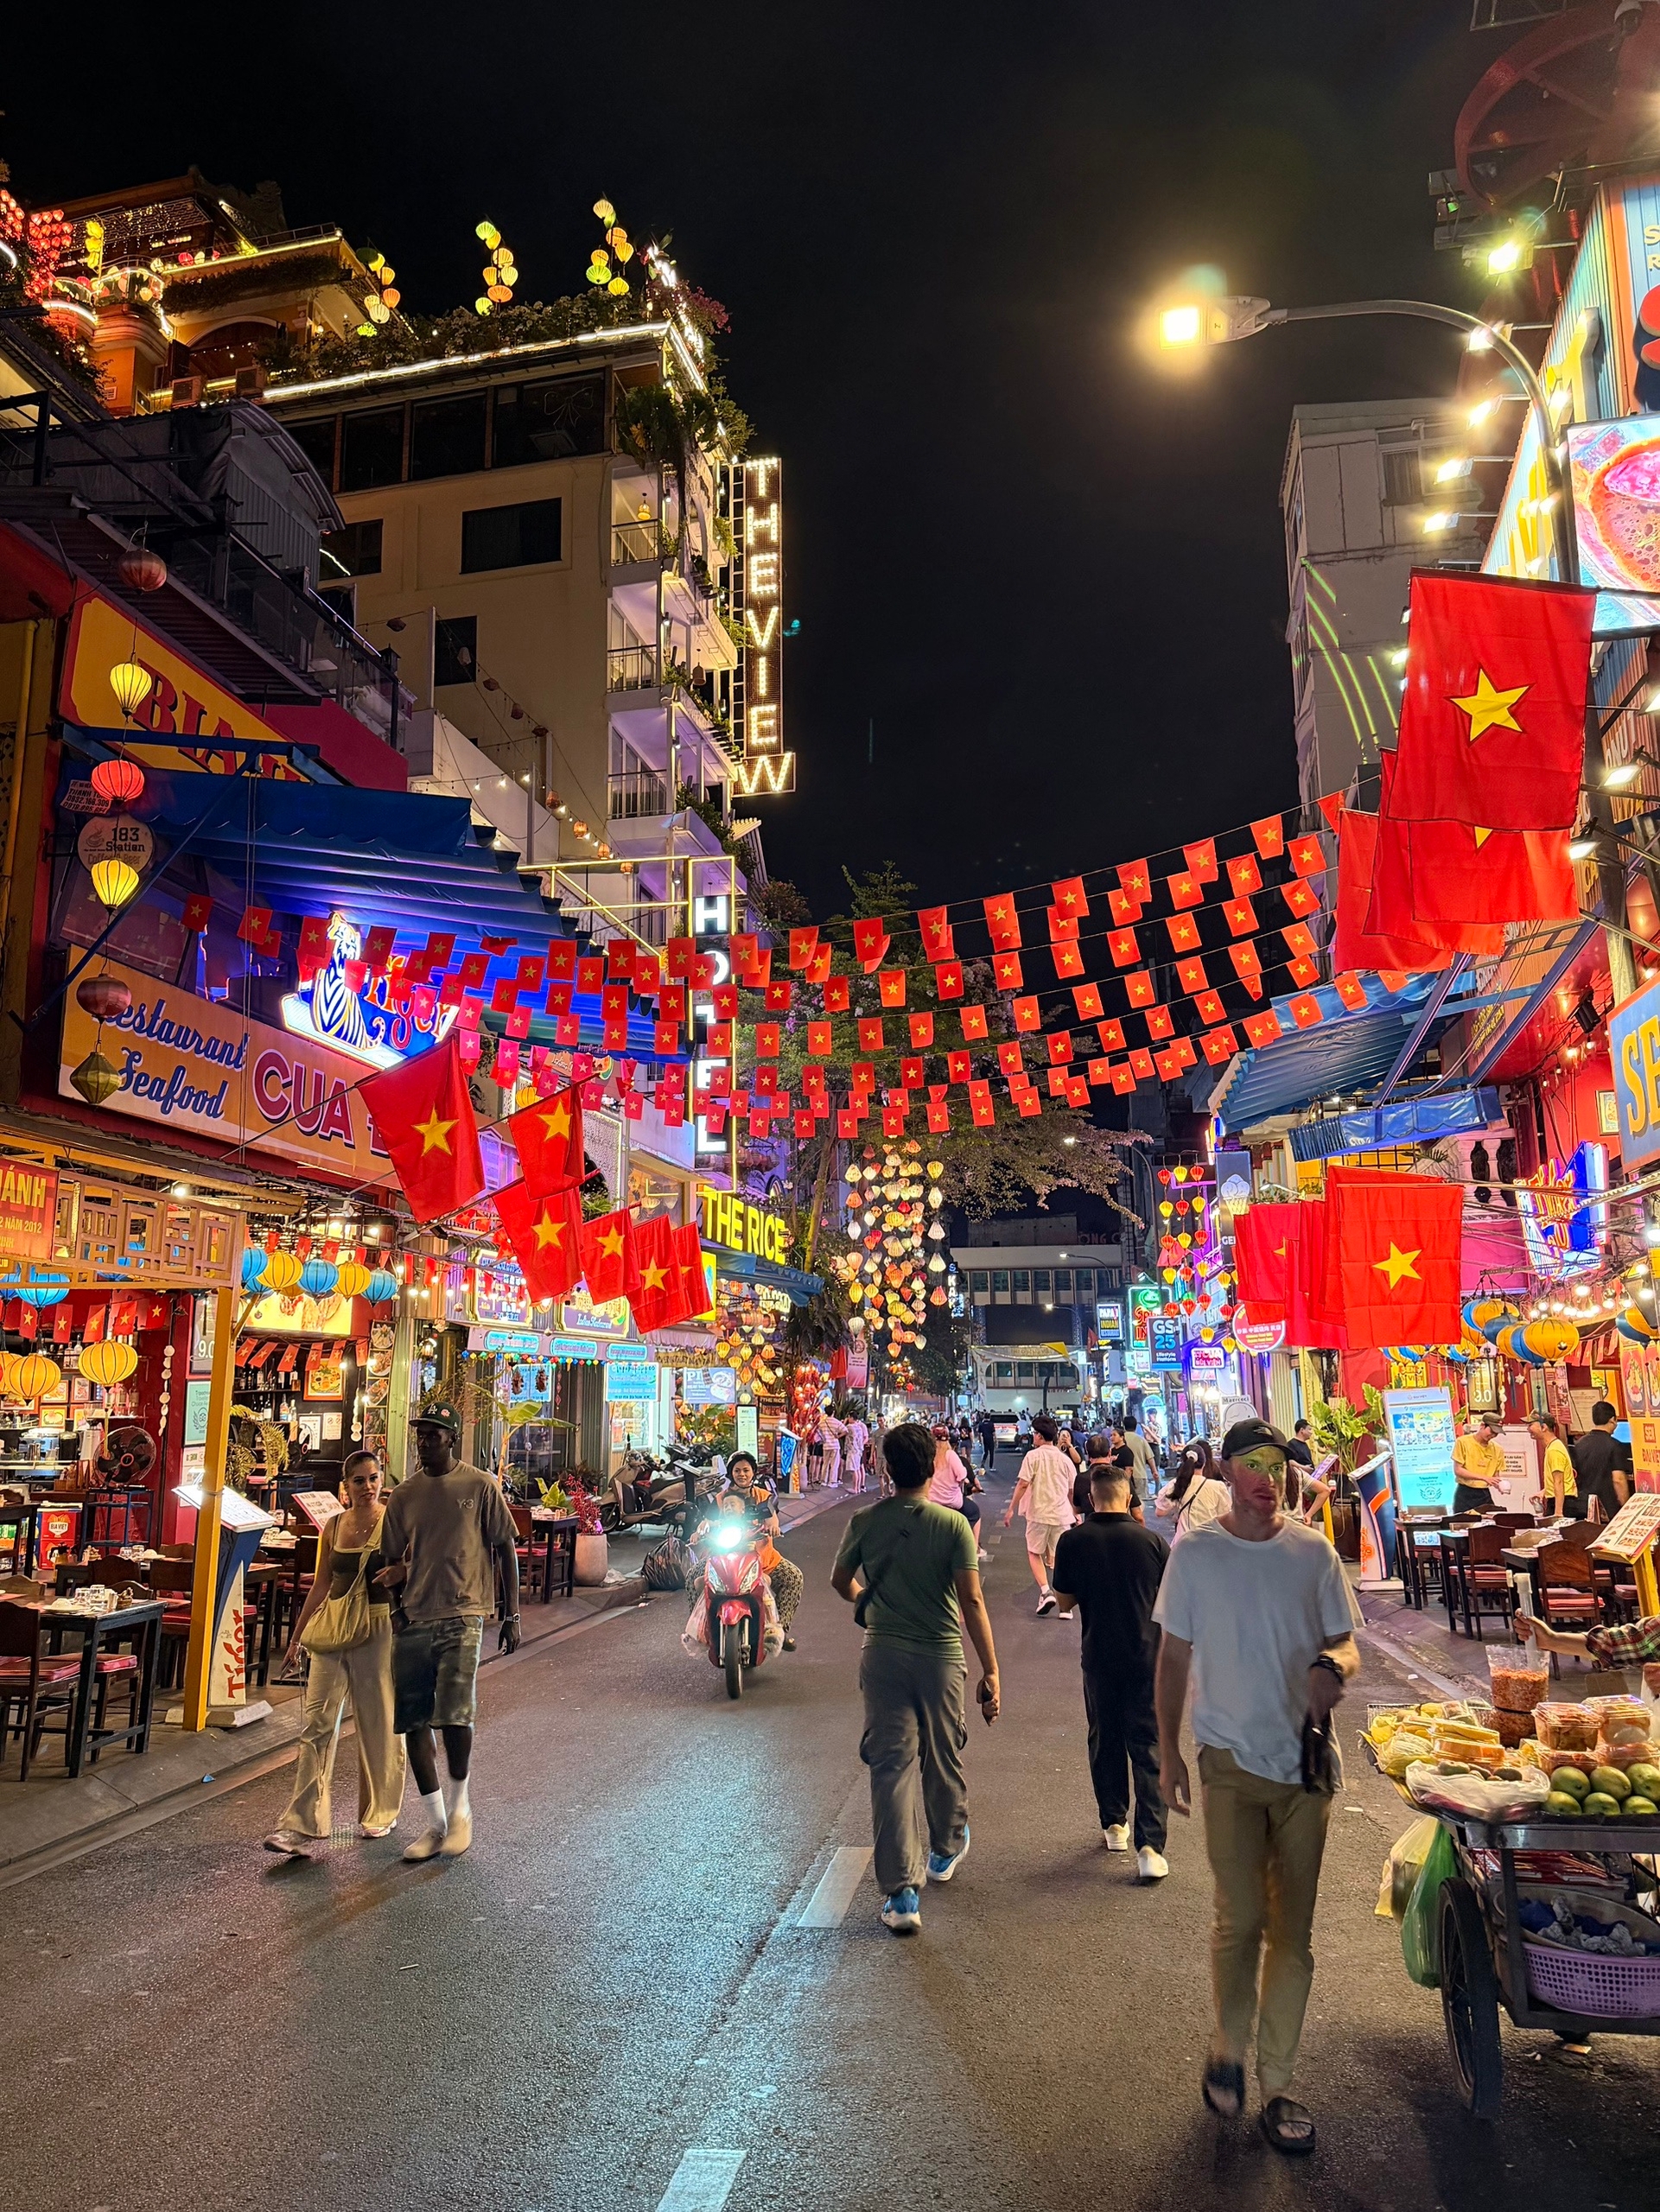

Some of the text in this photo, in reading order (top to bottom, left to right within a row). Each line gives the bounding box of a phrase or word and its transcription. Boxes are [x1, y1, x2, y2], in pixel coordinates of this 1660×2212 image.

[105, 841, 145, 852] Station
[111, 827, 140, 842] 183
[97, 998, 250, 1071] estaurant
[118, 1046, 229, 1121] Seafood
[252, 1047, 356, 1149] CUA
[0, 1164, 47, 1209] ÁNH
[24, 1220, 42, 1234] 2012
[702, 1184, 786, 1266] THE RICE
[1153, 1319, 1175, 1335] GS
[1154, 1334, 1176, 1351] 25
